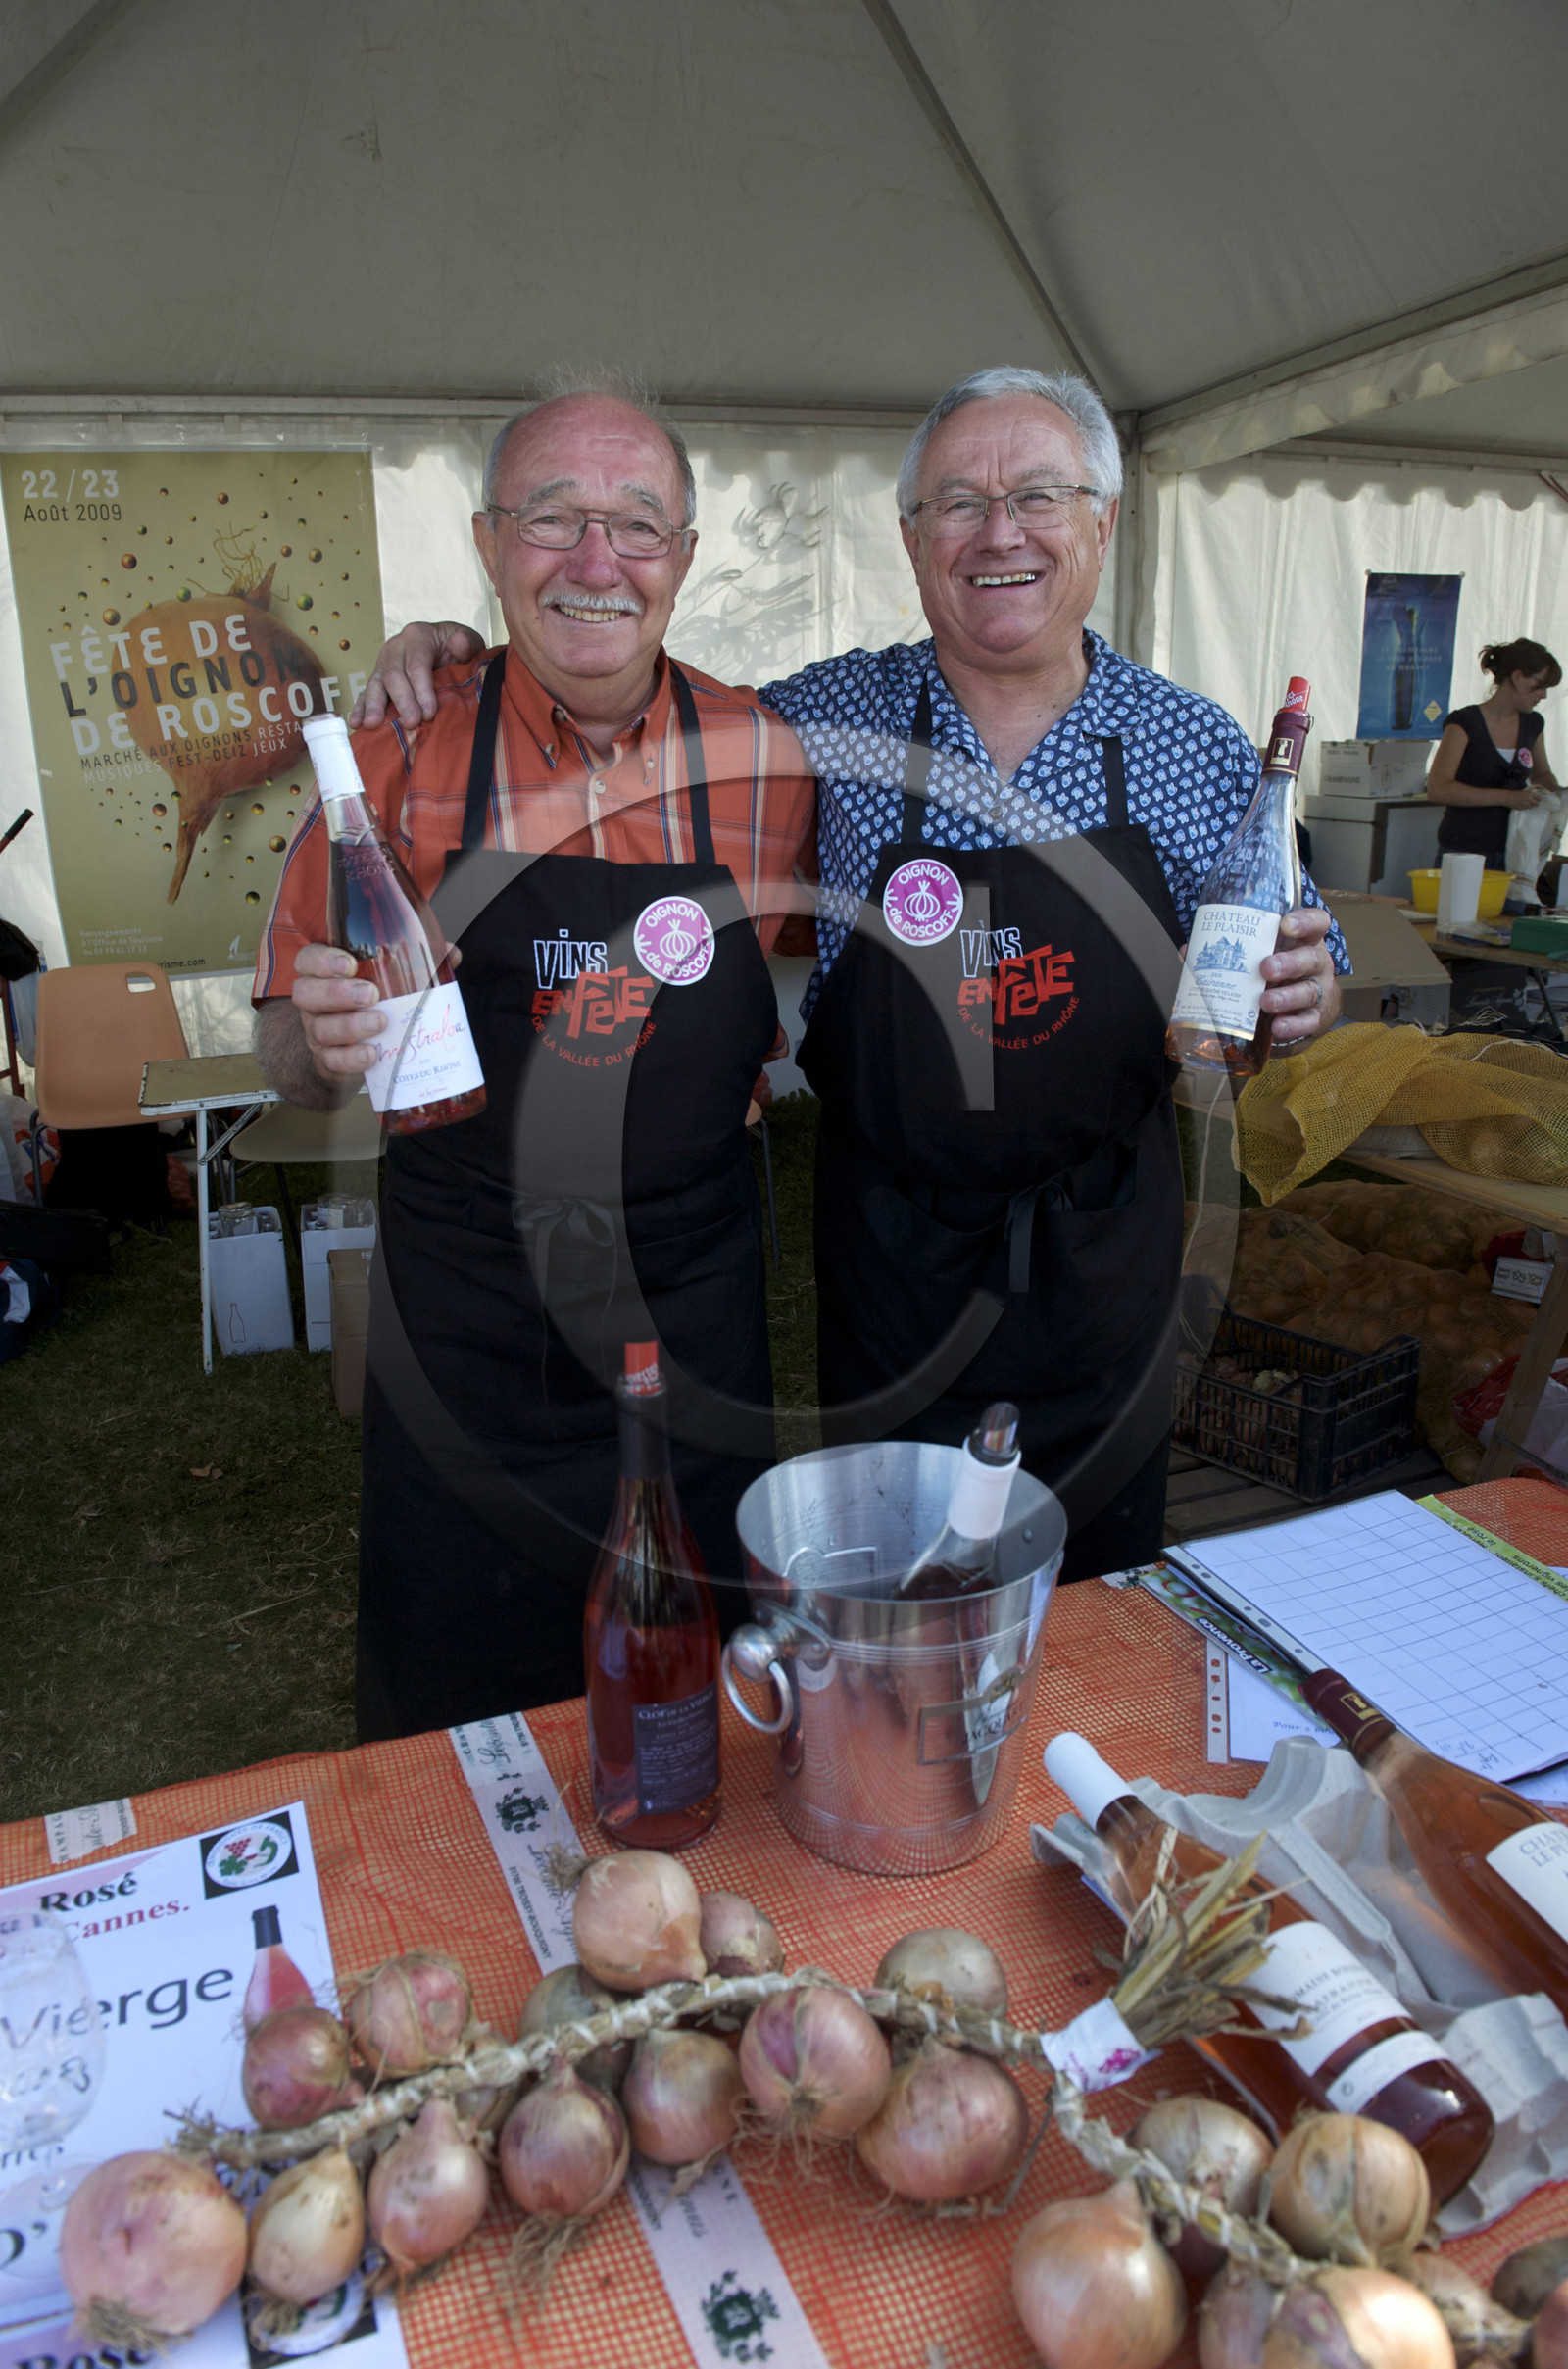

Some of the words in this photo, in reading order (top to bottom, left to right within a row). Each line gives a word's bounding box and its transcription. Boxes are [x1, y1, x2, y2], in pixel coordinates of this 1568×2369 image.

[24, 504, 68, 521] Août
[75, 503, 122, 521] 2009
[49, 624, 168, 680] FÊTE
[189, 614, 252, 658] DE
[60, 646, 302, 717] L'OIGNON
[70, 712, 134, 757] DE
[80, 746, 143, 770] MARCHÉ
[150, 743, 178, 758] AUX
[185, 729, 252, 752] OIGNONS
[84, 760, 163, 784] MUSIQUES
[169, 744, 247, 768] FEST-DEIZ
[253, 737, 287, 757] JEUX
[898, 864, 950, 886] OIGNON
[645, 903, 699, 927] OIGNON
[889, 907, 903, 924] de
[902, 909, 953, 938] ROSCOFF
[1201, 921, 1213, 932] LE
[1215, 922, 1258, 938] PLAISIR
[1203, 911, 1261, 926] CHÂTEAU
[646, 952, 662, 969] de
[662, 943, 709, 978] ROSCOFF
[532, 1015, 546, 1034] DE
[542, 1033, 556, 1052] LA
[559, 1046, 600, 1067] VALLÉE
[605, 1053, 622, 1065] DU
[624, 1020, 657, 1058] RHÔNE
[958, 1007, 973, 1023] DE
[970, 1023, 984, 1039] LA
[988, 1034, 1028, 1050] VALLÉE
[1033, 1030, 1050, 1045] DU
[1051, 996, 1079, 1034] RHÔNE
[1198, 1617, 1253, 1661] Provence
[1250, 1659, 1271, 1674] La
[1273, 1721, 1301, 1730] Pour
[39, 1870, 138, 1911] Rosé
